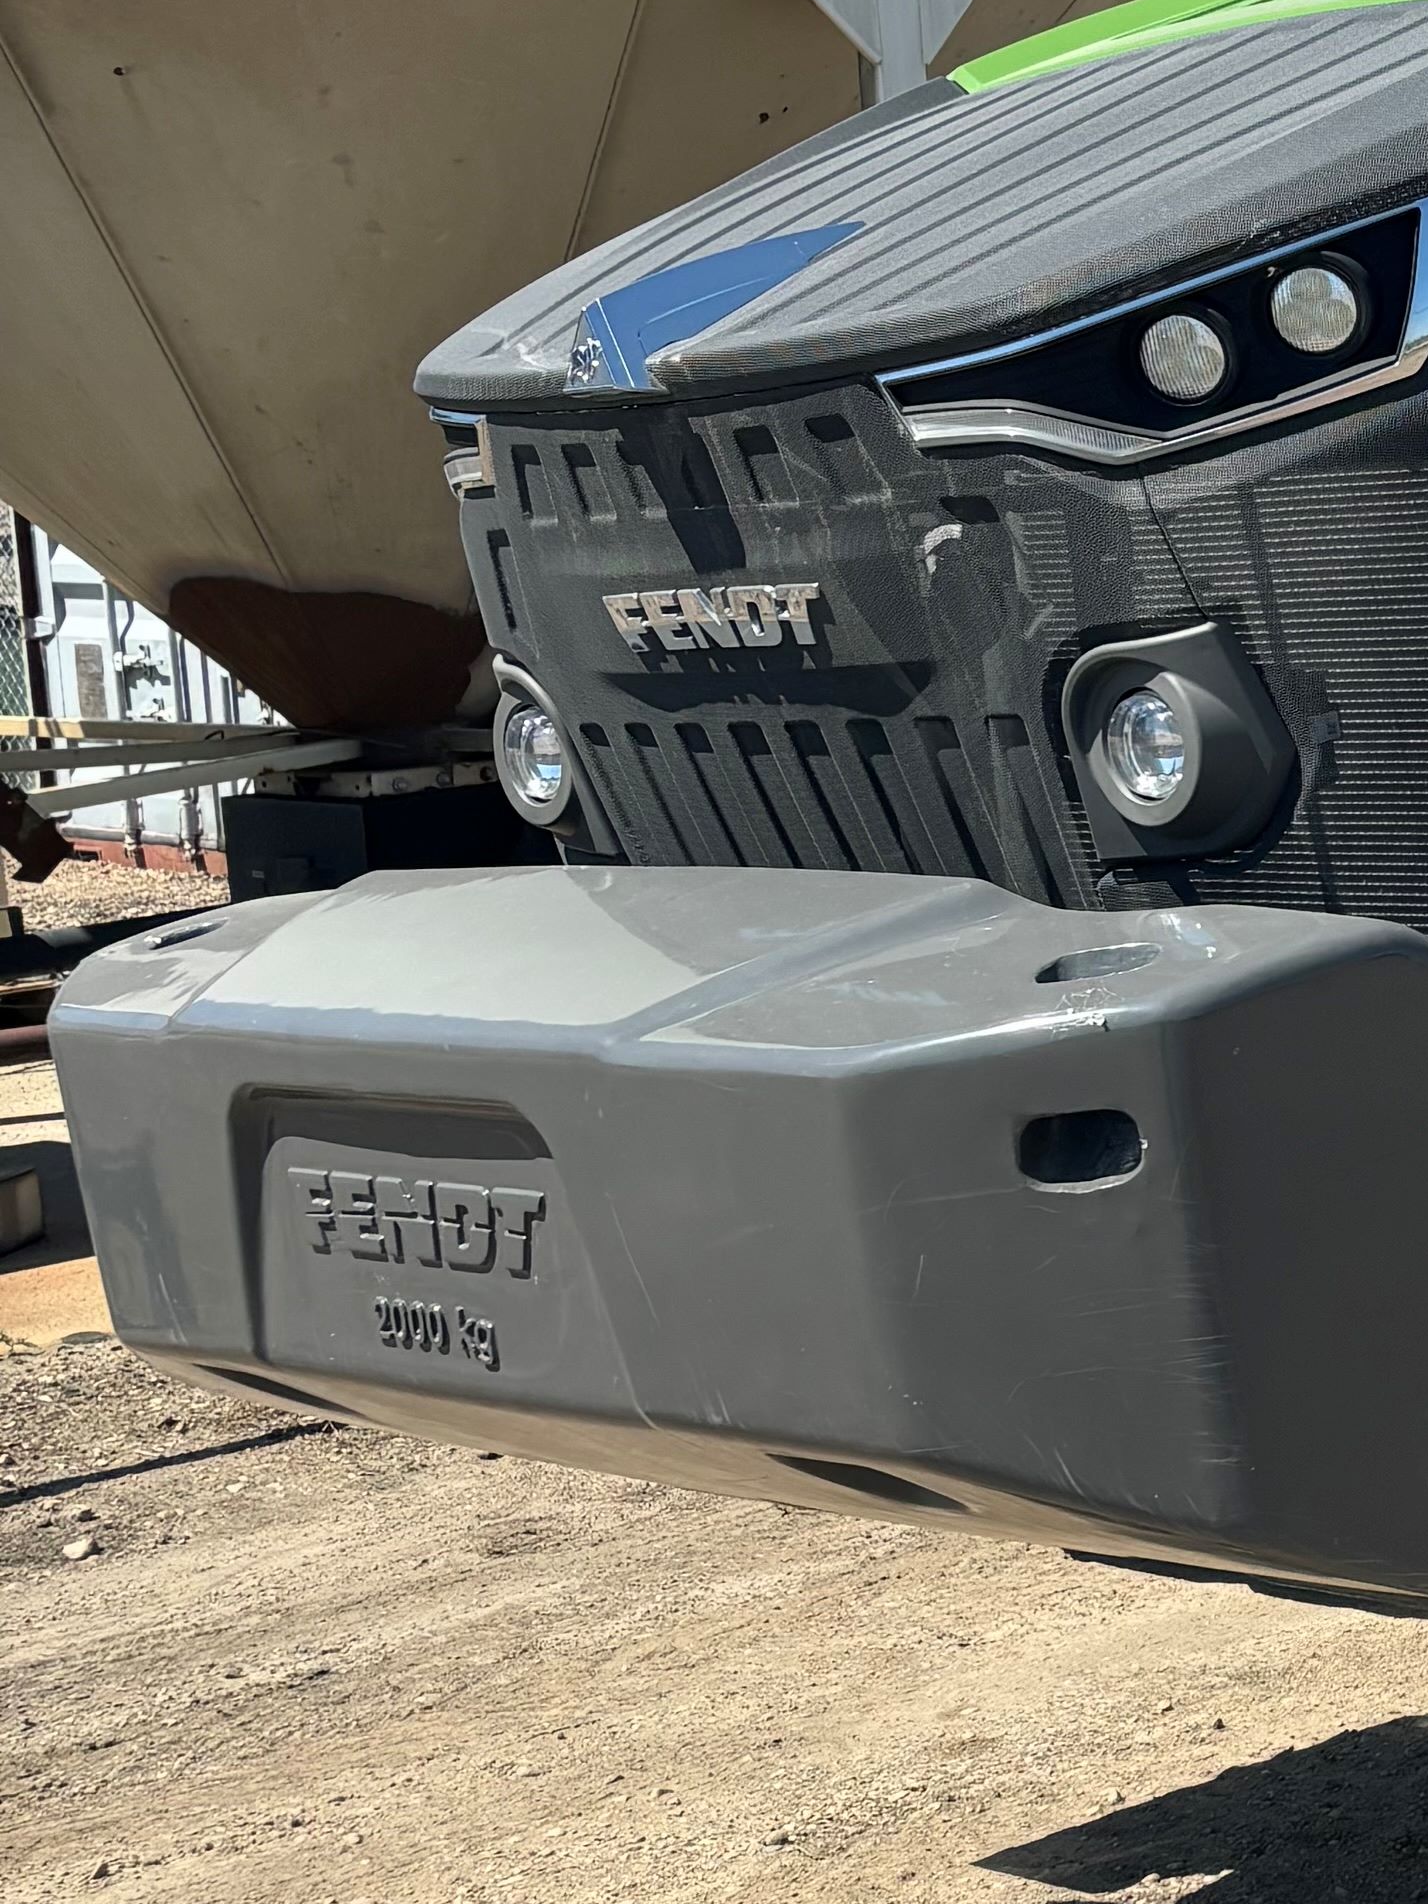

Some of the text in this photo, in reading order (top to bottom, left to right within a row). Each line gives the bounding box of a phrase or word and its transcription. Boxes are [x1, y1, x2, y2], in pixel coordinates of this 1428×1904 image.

[602, 581, 820, 653] FENDT
[286, 1166, 546, 1280] FENDT
[373, 1295, 500, 1373] 2000 kg
